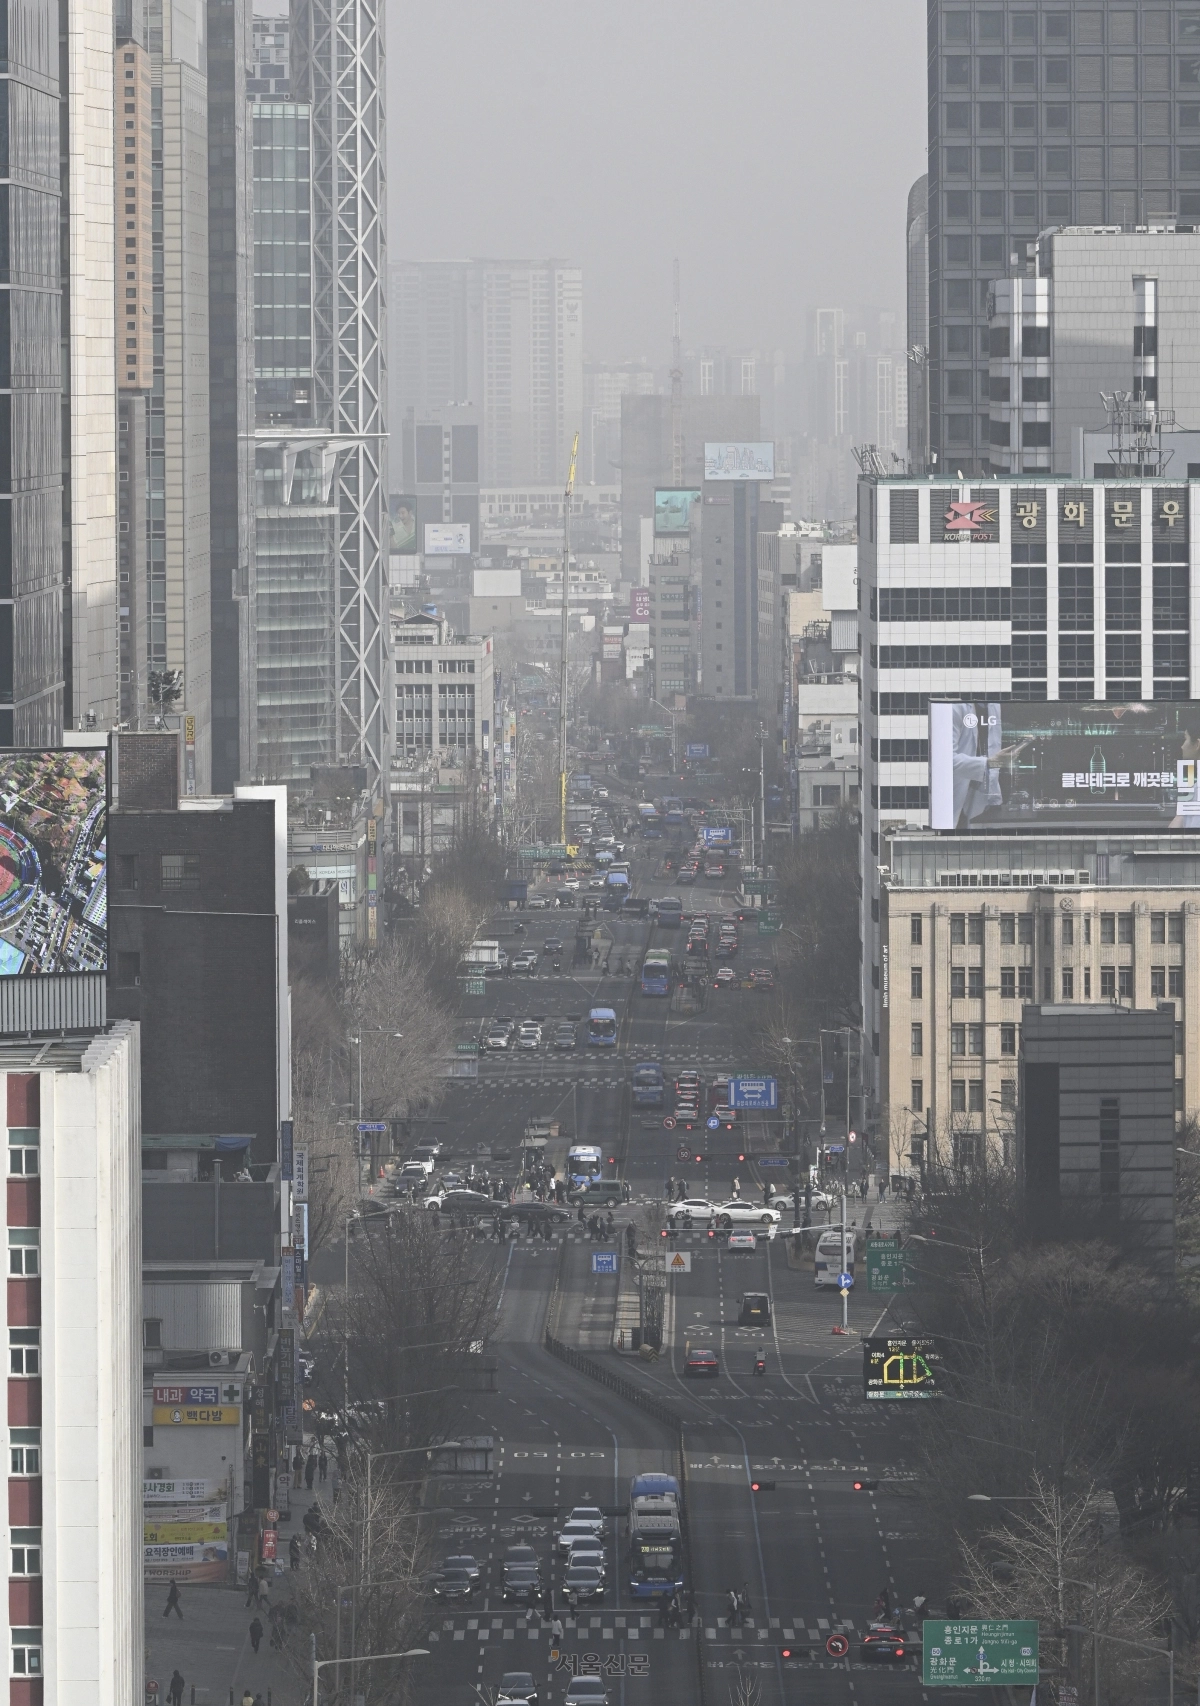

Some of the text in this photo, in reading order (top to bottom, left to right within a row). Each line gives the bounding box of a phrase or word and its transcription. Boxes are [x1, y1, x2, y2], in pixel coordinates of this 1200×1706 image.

[1016, 501, 1184, 528] 광화문우
[981, 716, 997, 726] LG
[1062, 771, 1174, 788] 클린테크로 깨끗한
[156, 1388, 217, 1403] 내과 약국
[144, 1546, 194, 1557] 요직장인예배
[944, 1625, 978, 1635] 흥인지문
[944, 1636, 978, 1645] 종로1가
[930, 1657, 957, 1666] 광화문
